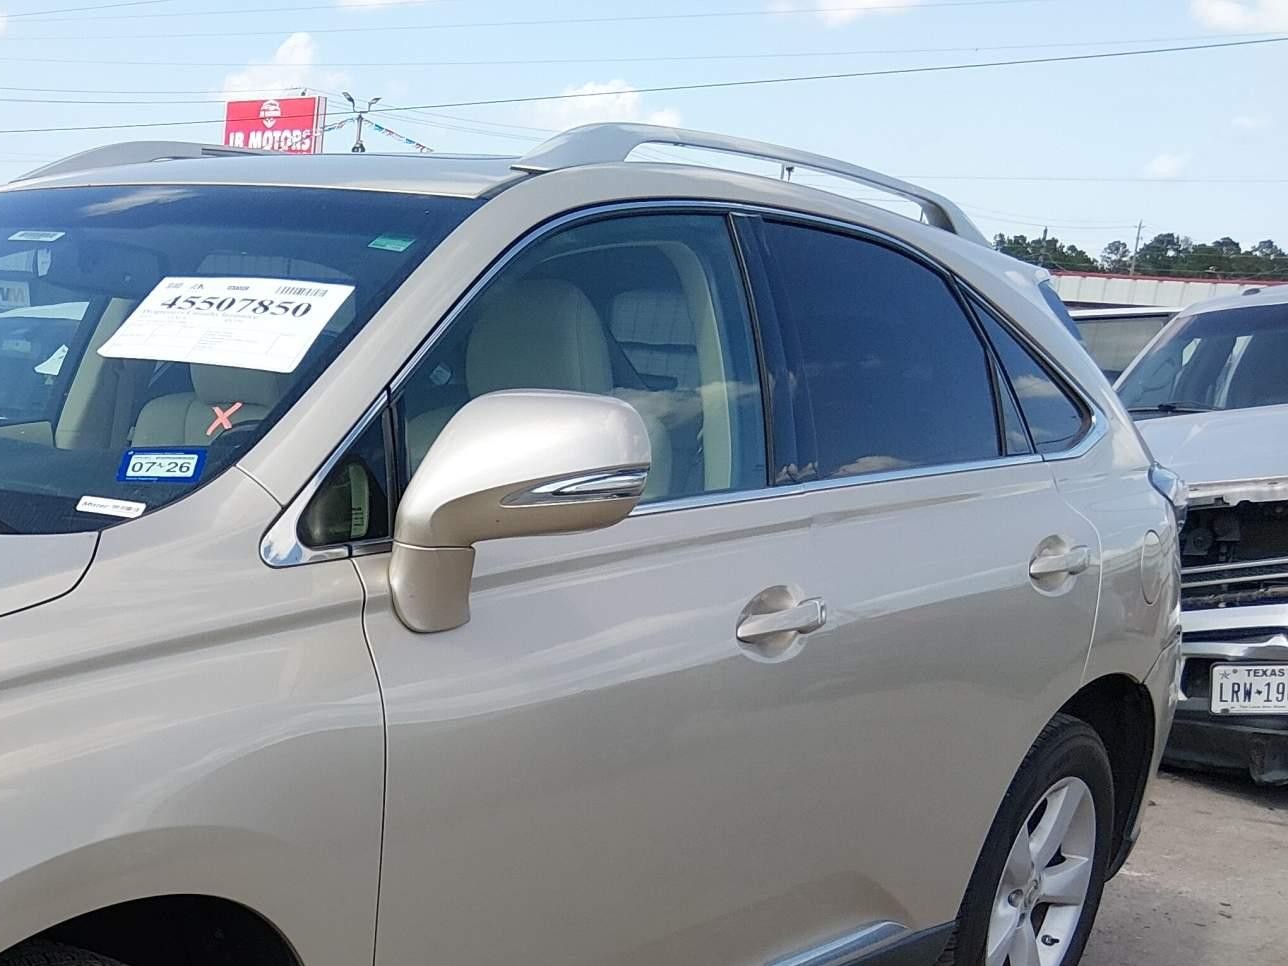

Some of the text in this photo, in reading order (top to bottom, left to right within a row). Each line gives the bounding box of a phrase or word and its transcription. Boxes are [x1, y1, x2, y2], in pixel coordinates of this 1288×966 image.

[248, 129, 311, 151] MOTORS
[160, 295, 313, 318] 45507850
[131, 461, 192, 473] 07 26
[1245, 668, 1285, 678] TEXAS
[1263, 682, 1288, 703] 19
